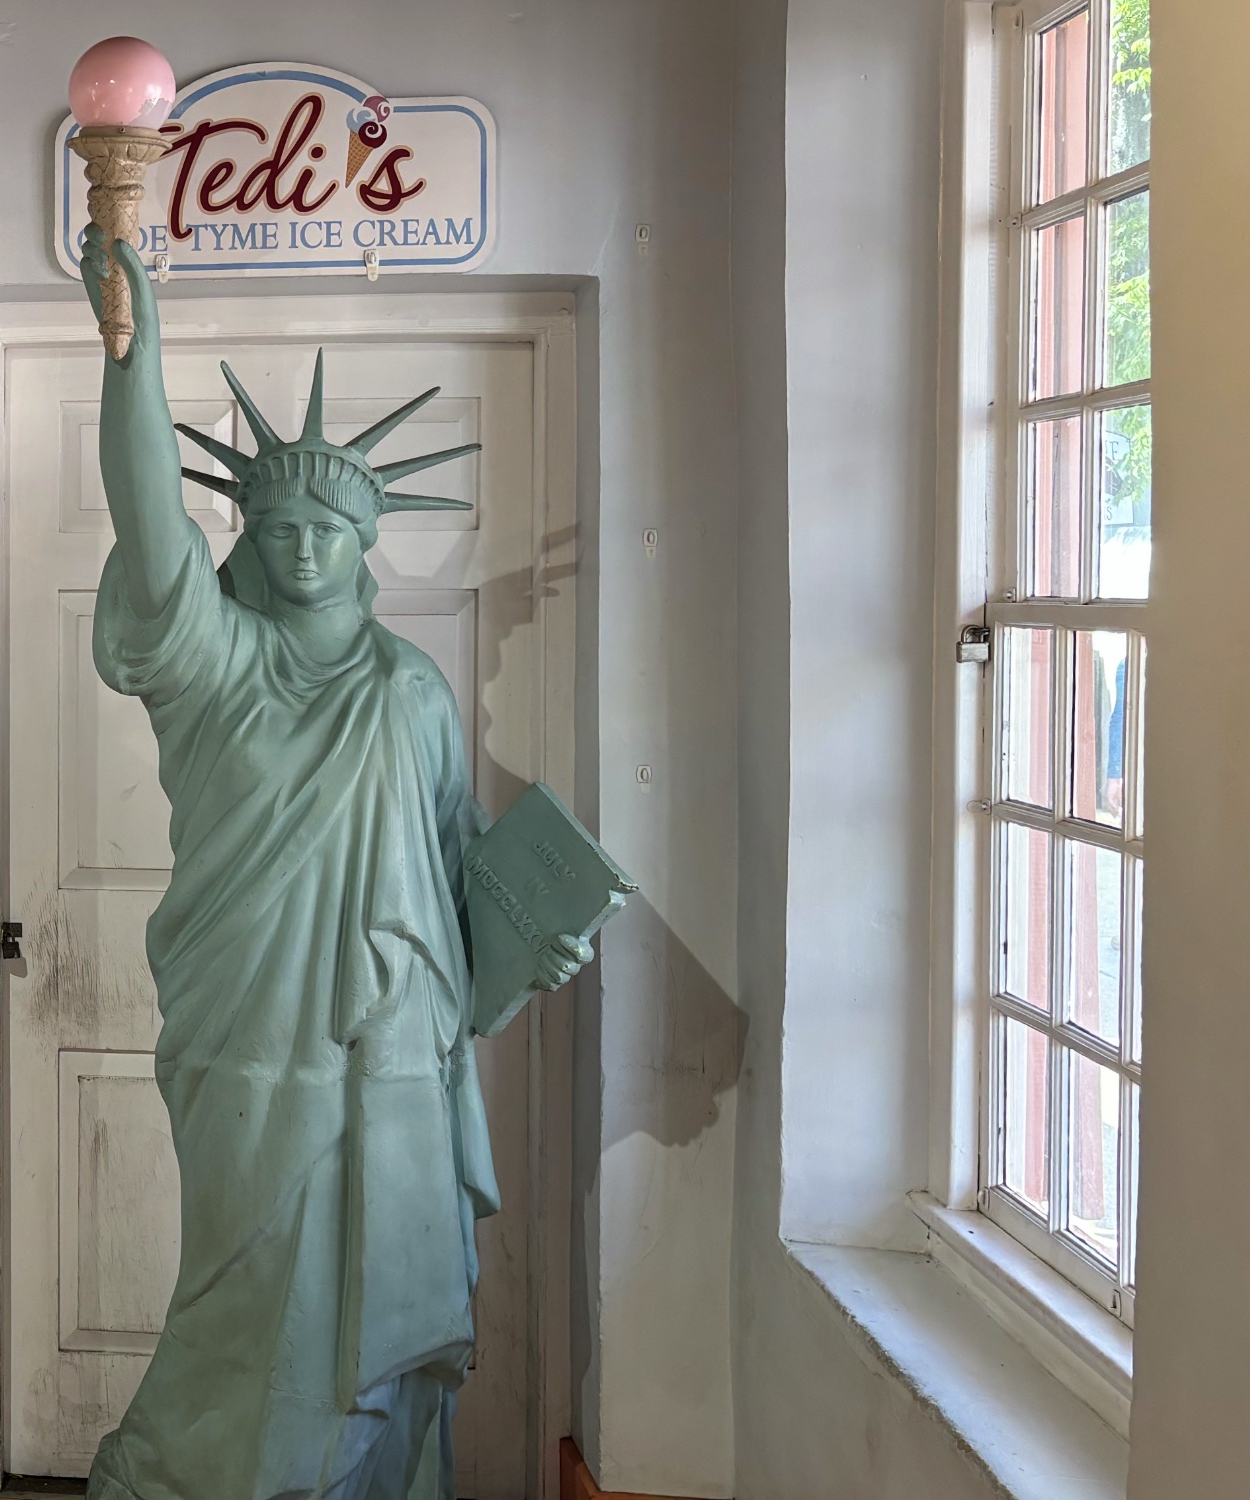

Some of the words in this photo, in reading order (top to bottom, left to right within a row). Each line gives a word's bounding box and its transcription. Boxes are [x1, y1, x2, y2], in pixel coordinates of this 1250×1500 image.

[157, 91, 426, 241] Tedi's
[186, 222, 279, 252] TYME
[288, 220, 343, 249] ICE
[352, 217, 475, 248] CREAM
[532, 840, 576, 882] JULY
